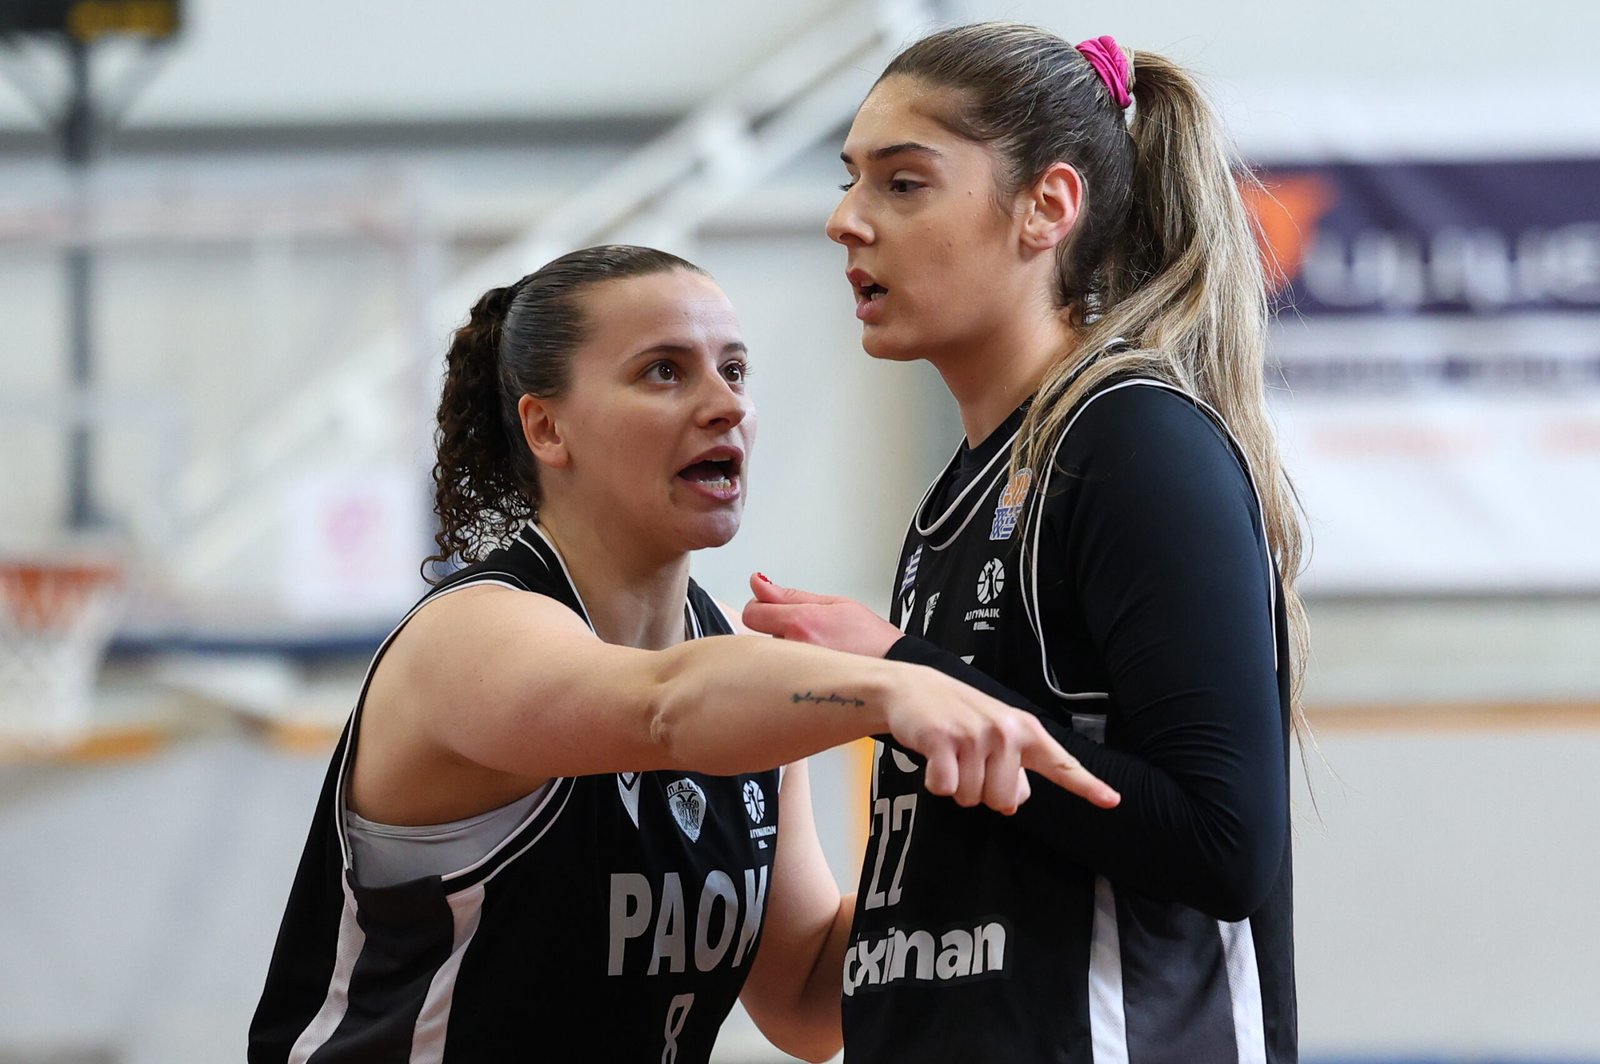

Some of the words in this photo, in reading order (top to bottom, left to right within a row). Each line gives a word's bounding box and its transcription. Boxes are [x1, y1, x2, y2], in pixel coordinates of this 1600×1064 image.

[864, 793, 918, 911] 22
[607, 864, 769, 976] PAOK
[661, 992, 695, 1064] 8
